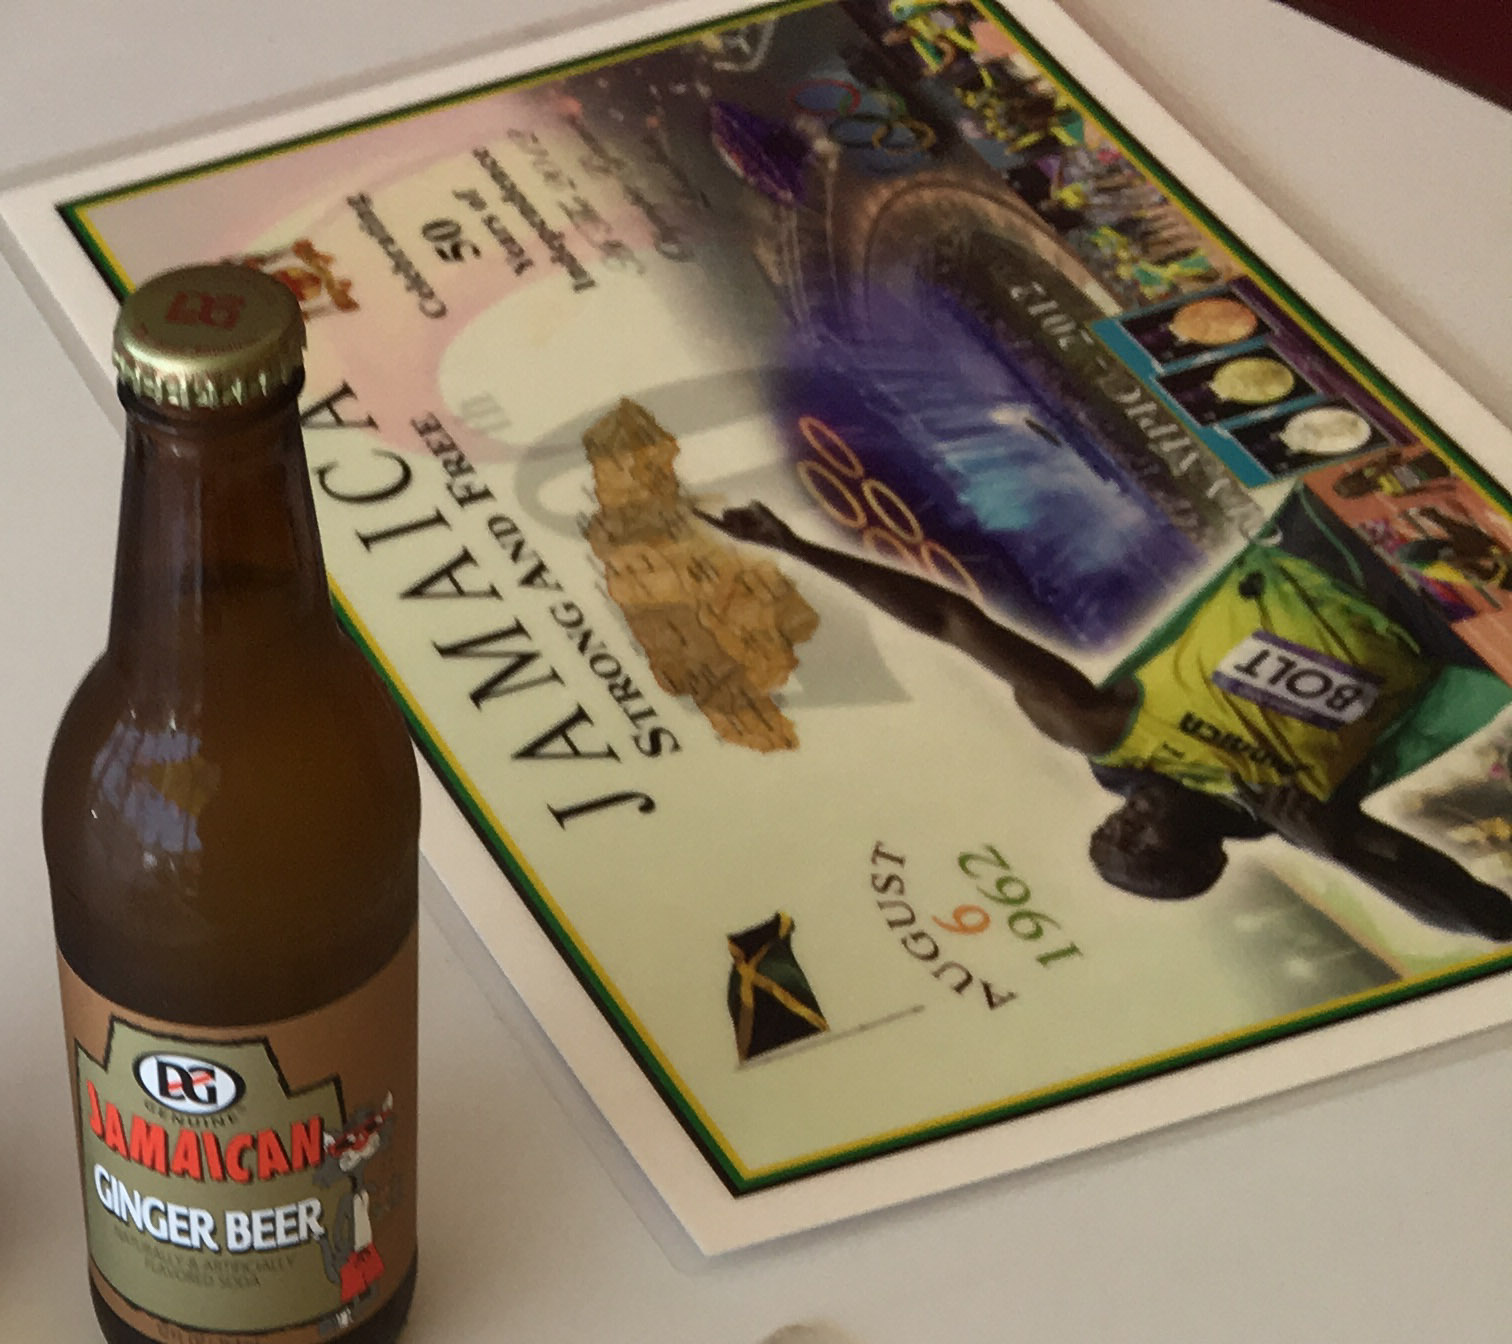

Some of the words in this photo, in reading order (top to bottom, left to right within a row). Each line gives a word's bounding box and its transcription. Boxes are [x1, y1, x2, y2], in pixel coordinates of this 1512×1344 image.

[421, 218, 482, 263] 50
[410, 411, 497, 510] FREE
[486, 512, 564, 594] AND
[300, 380, 657, 831] JAMAICA
[549, 600, 683, 760] STRONG
[1233, 649, 1364, 713] BOLT
[870, 840, 1019, 1011] AUGUST
[931, 904, 991, 935] 6
[957, 843, 1083, 968] 1962
[86, 1079, 323, 1184] JAMAICAN
[93, 1163, 220, 1253] GINGER
[224, 1197, 326, 1252] BEER
